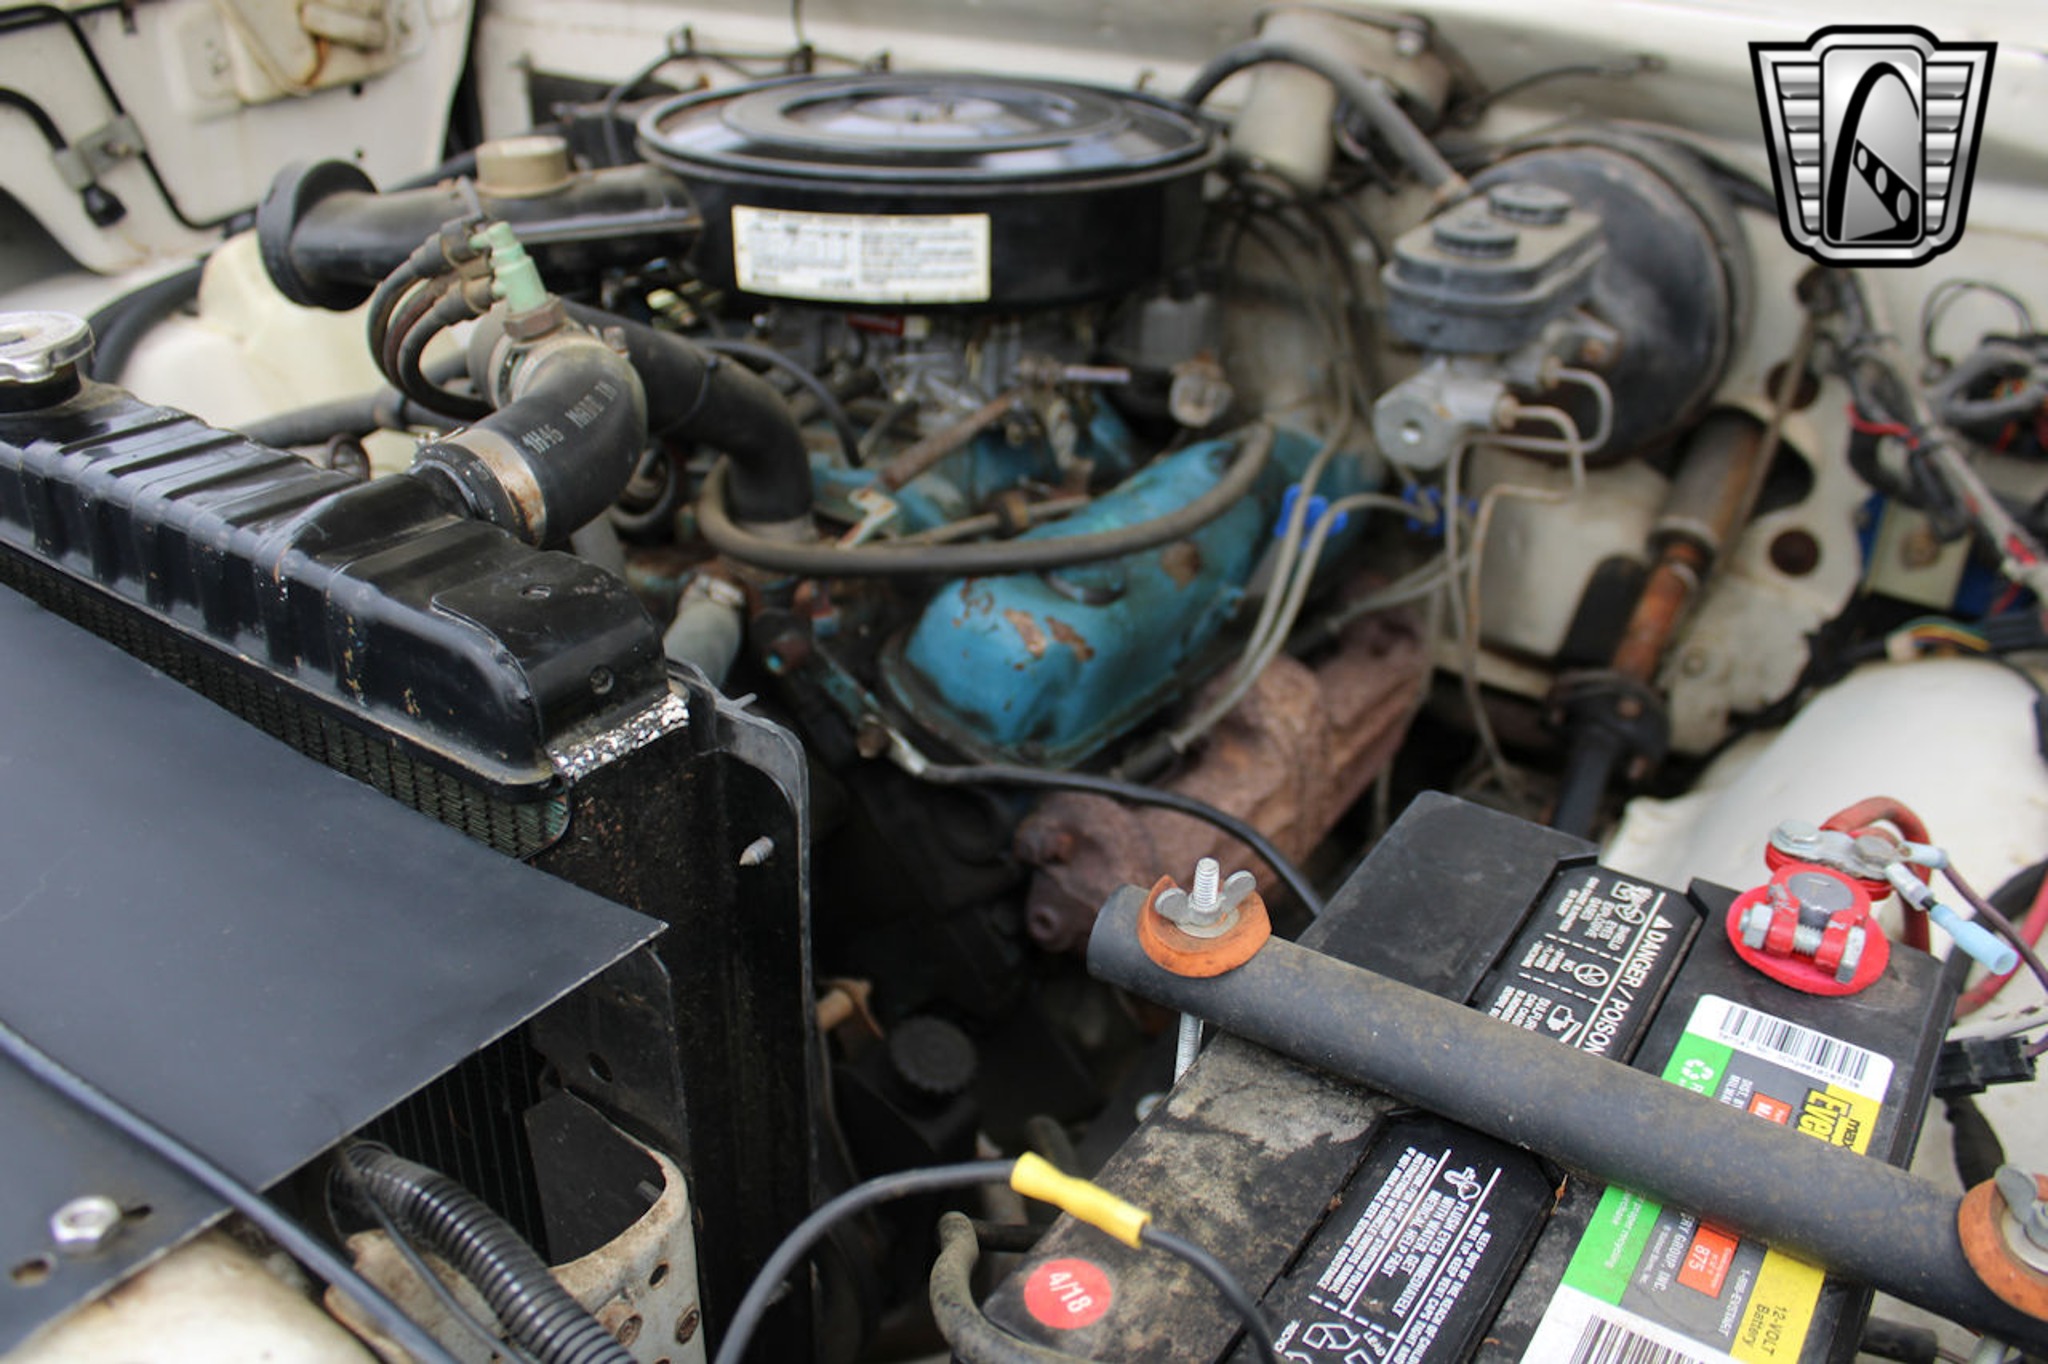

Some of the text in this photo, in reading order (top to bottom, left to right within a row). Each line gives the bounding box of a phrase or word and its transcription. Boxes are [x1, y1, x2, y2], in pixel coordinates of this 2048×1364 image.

[1622, 930, 1666, 987] DANGER
[1584, 998, 1628, 1054] POISON
[1433, 1197, 1455, 1220] WITH
[1381, 1191, 1441, 1277] MEDICAL HELP FAST
[1661, 1234, 1686, 1268] GROUP,
[1393, 1202, 1468, 1316] FLUSH EYES IMMEDIATELY
[1400, 1254, 1419, 1275] GET
[1689, 1245, 1710, 1271] 875
[1049, 1271, 1094, 1313] 4/18
[1652, 1270, 1670, 1291] INC.
[1363, 1331, 1386, 1357] LEAD
[1742, 1304, 1770, 1346] Battery
[1762, 1306, 1787, 1354] 12-VOLT
